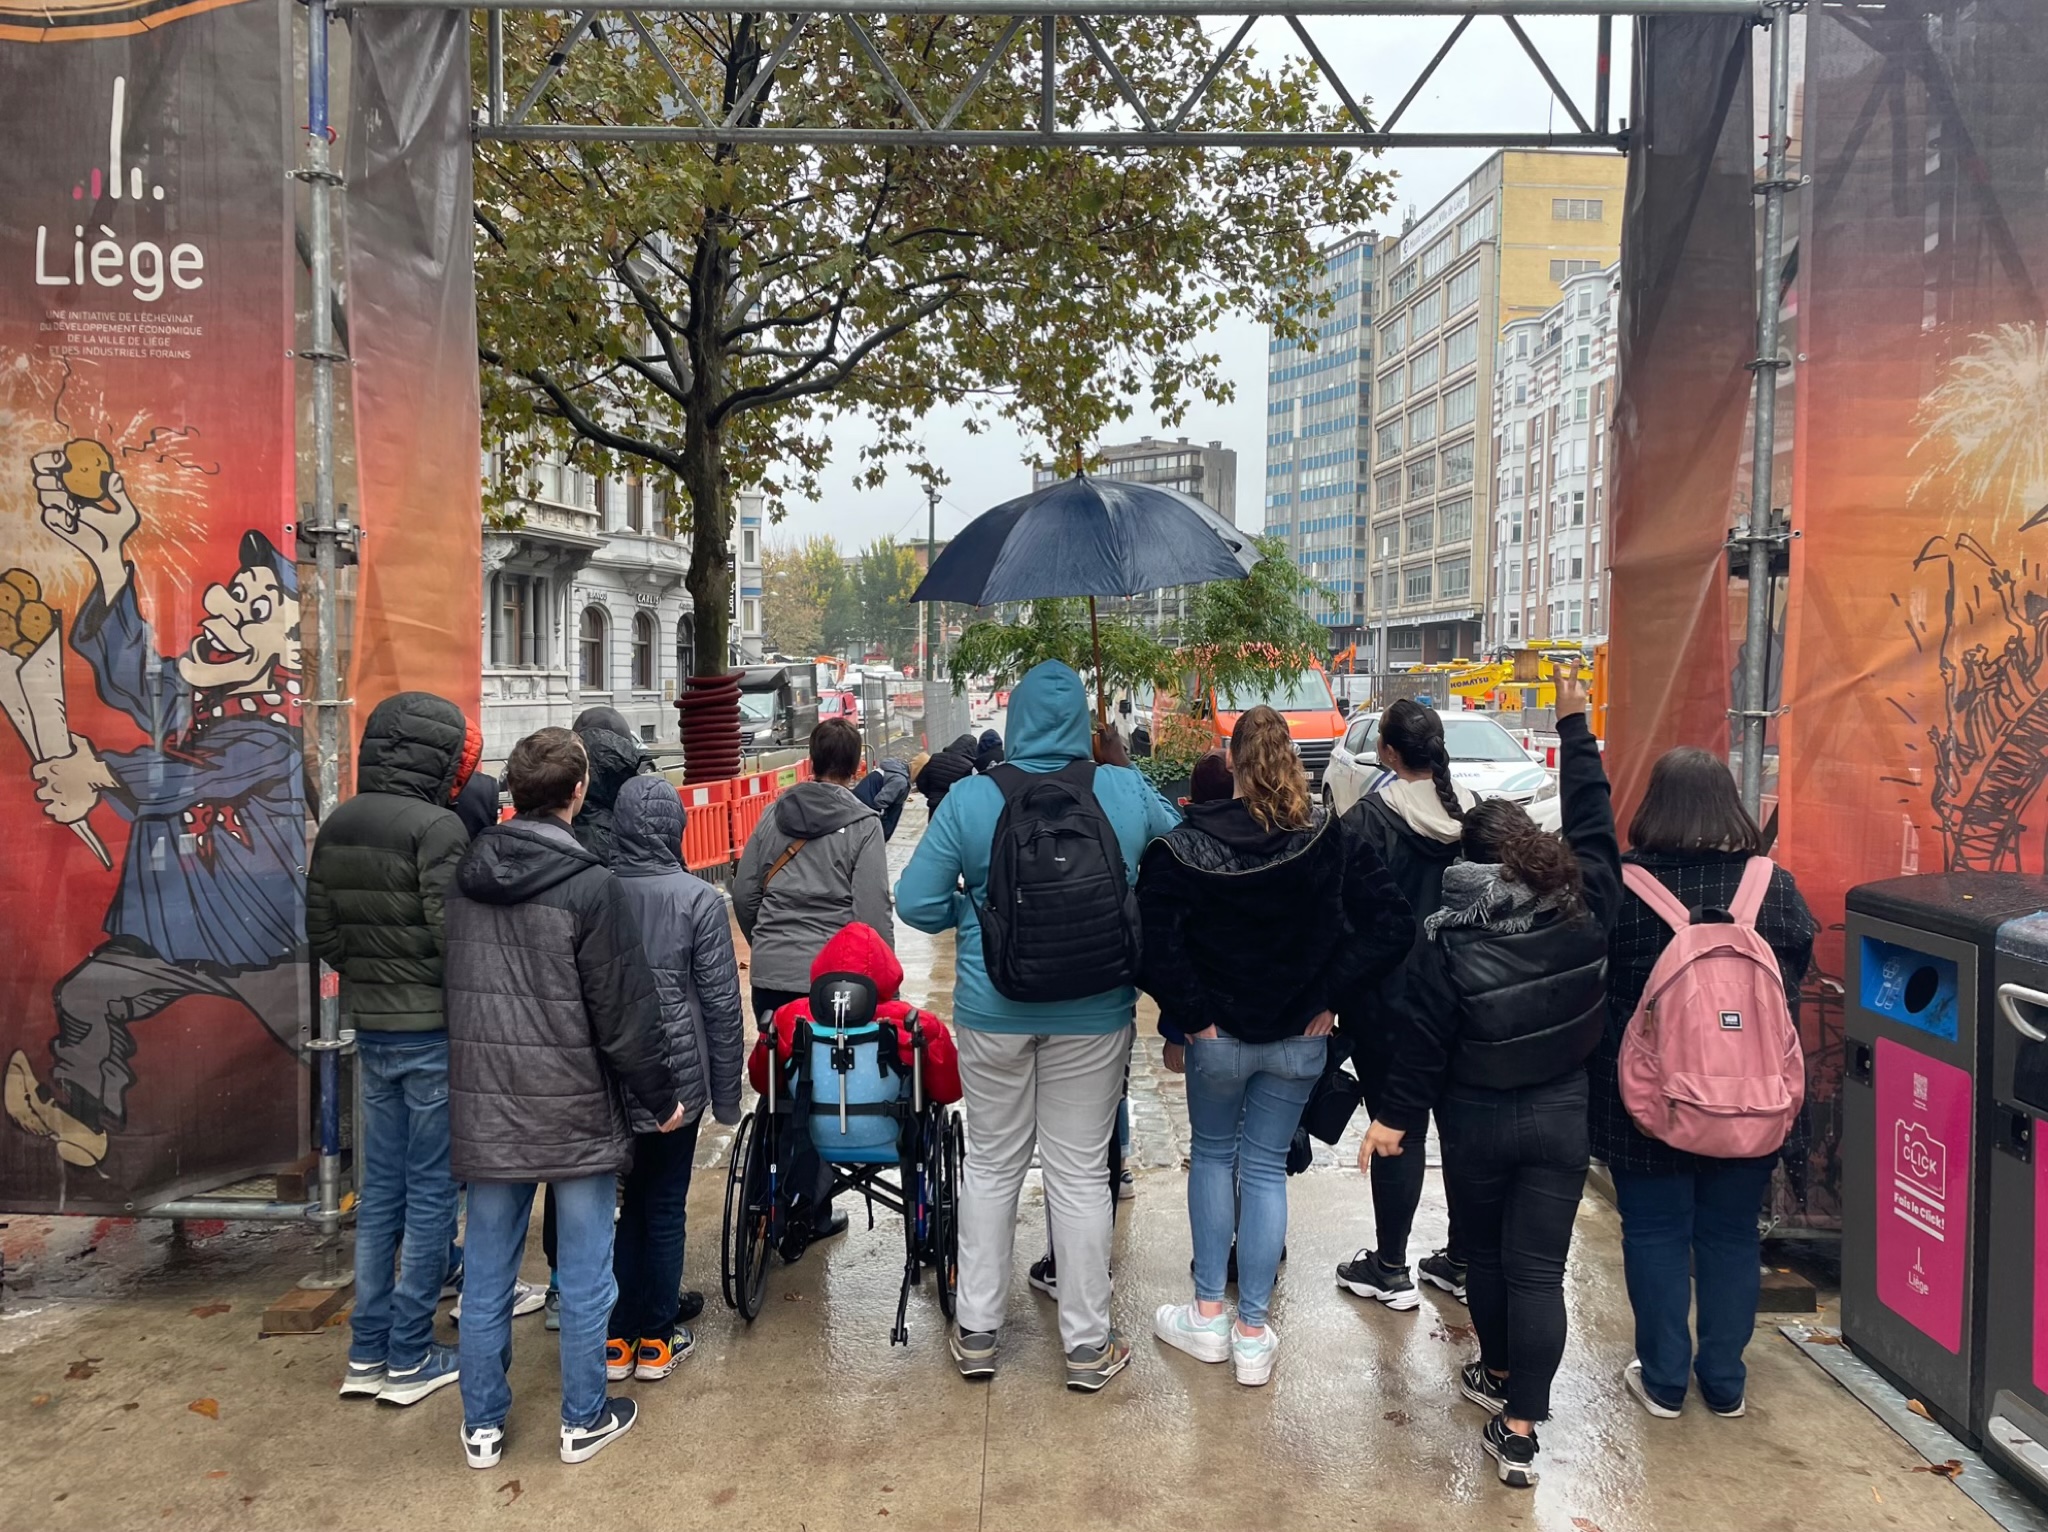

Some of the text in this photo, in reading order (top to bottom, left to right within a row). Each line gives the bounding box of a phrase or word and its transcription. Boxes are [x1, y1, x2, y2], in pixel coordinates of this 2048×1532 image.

[35, 224, 204, 302] Liège
[46, 310, 194, 323] UNE INITIATIVE DE L'ÉCHEVINAT
[40, 320, 203, 336] DU DÉVELOPPEMENT ÉCONOMIQUE
[67, 333, 170, 347] DE LA VILLE DE LIÈGE
[49, 345, 191, 359] ET DES INDUSTRIELS FORAINS
[1450, 677, 1489, 688] KOMATSU
[1903, 1146, 1937, 1175] CLICK
[1894, 1192, 1944, 1230] Fais le Click!
[1908, 1271, 1929, 1295] Liège
